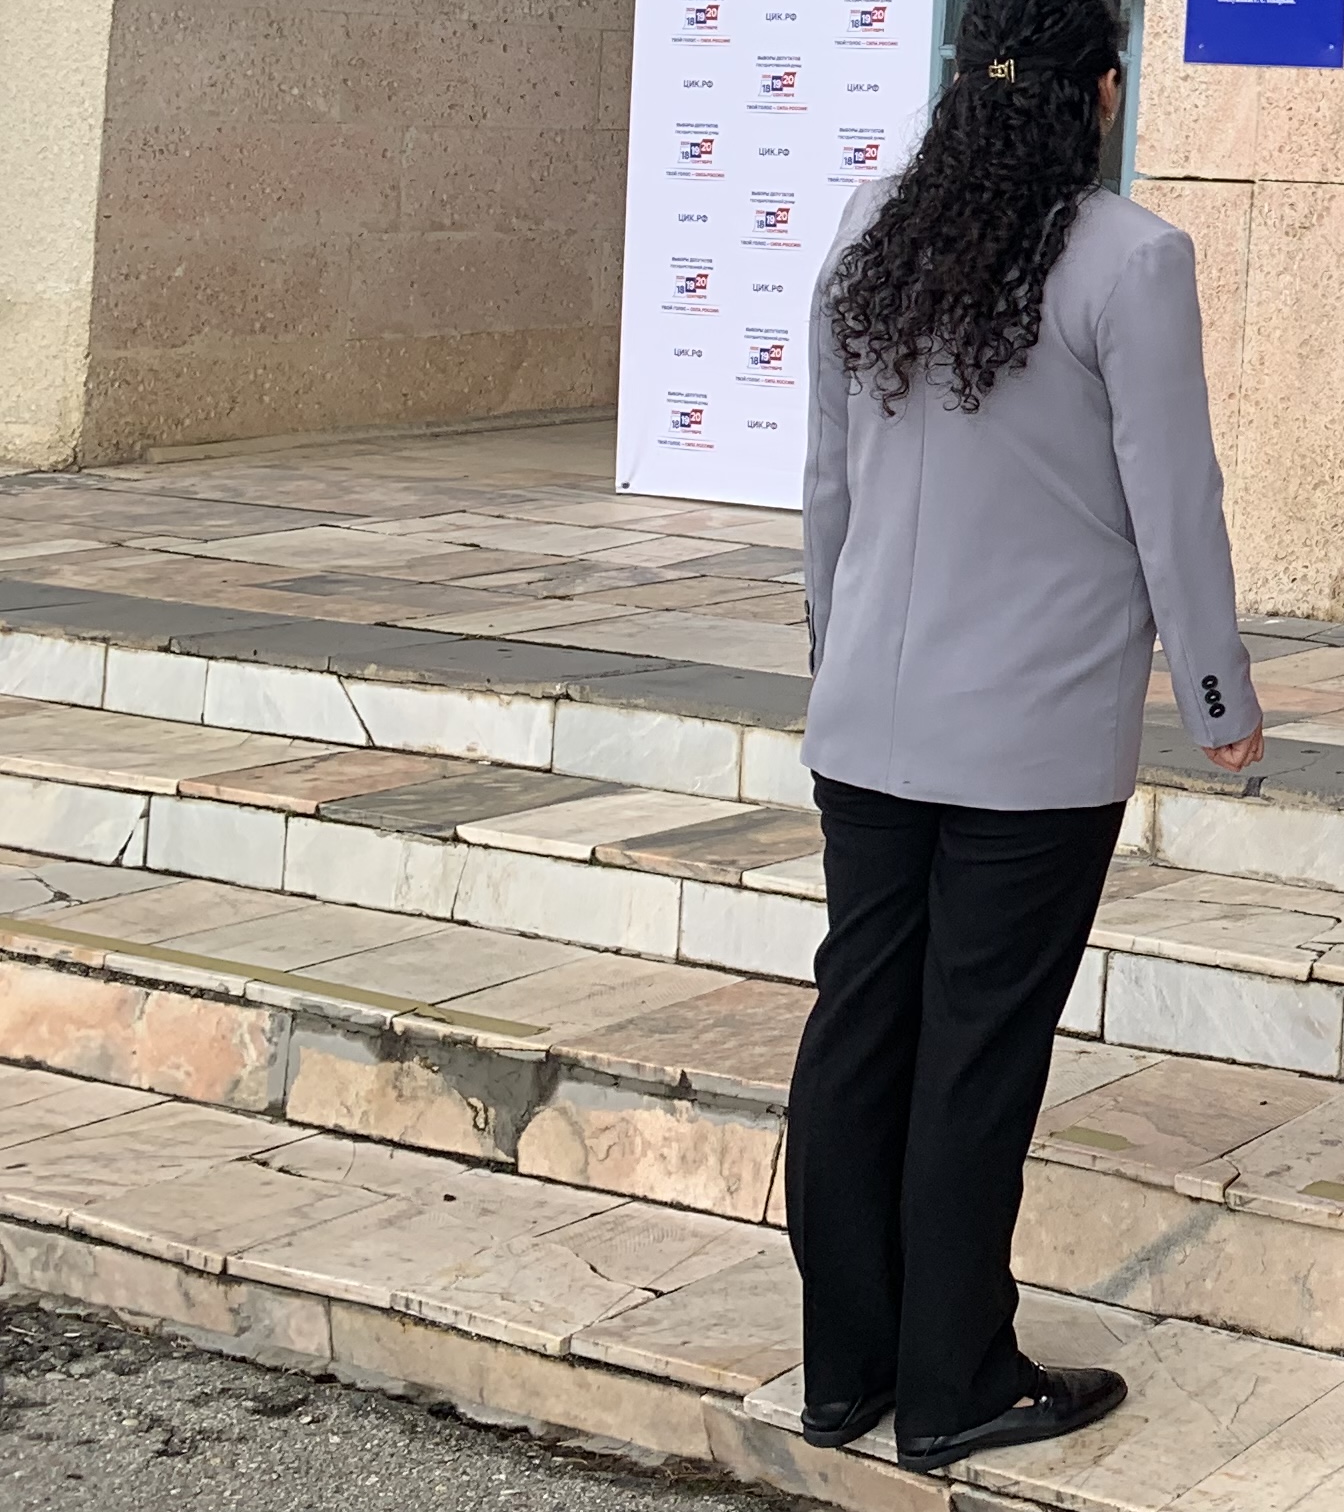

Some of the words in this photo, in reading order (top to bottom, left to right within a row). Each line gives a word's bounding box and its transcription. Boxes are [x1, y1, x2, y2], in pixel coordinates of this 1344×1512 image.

[686, 17, 695, 26] 18
[696, 12, 705, 22] 19
[706, 8, 717, 17] 20
[765, 12, 797, 21] ЦИК.РФ
[851, 19, 860, 28] 18
[862, 14, 871, 24] 19
[872, 10, 884, 19] 20
[683, 80, 713, 88] ЦИК.РФ
[762, 84, 771, 93] 18
[772, 79, 782, 89] 19
[782, 75, 794, 85] 20
[847, 83, 879, 92] ЦИК.РФ
[681, 151, 690, 160] 18
[691, 146, 700, 156] 19
[701, 142, 712, 152] 20
[758, 148, 790, 156] ЦИК.РФ
[844, 157, 853, 166] 18
[854, 152, 864, 161] 19
[865, 148, 877, 157] 20
[678, 214, 708, 223] ЦИК.РФ
[756, 220, 765, 229] 18
[766, 215, 775, 225] 19
[776, 211, 788, 221] 20
[676, 285, 685, 294] 18
[686, 280, 695, 290] 19
[696, 276, 707, 286] 20
[753, 283, 783, 293] ЦИК.РФ
[674, 348, 703, 357] ЦИК.РФ
[750, 356, 759, 365] 18
[761, 351, 770, 361] 19
[770, 348, 782, 358] 20
[672, 419, 680, 429] 18
[681, 415, 690, 425] 19
[691, 412, 701, 422] 20
[747, 420, 777, 430] ЦИК.РФ
